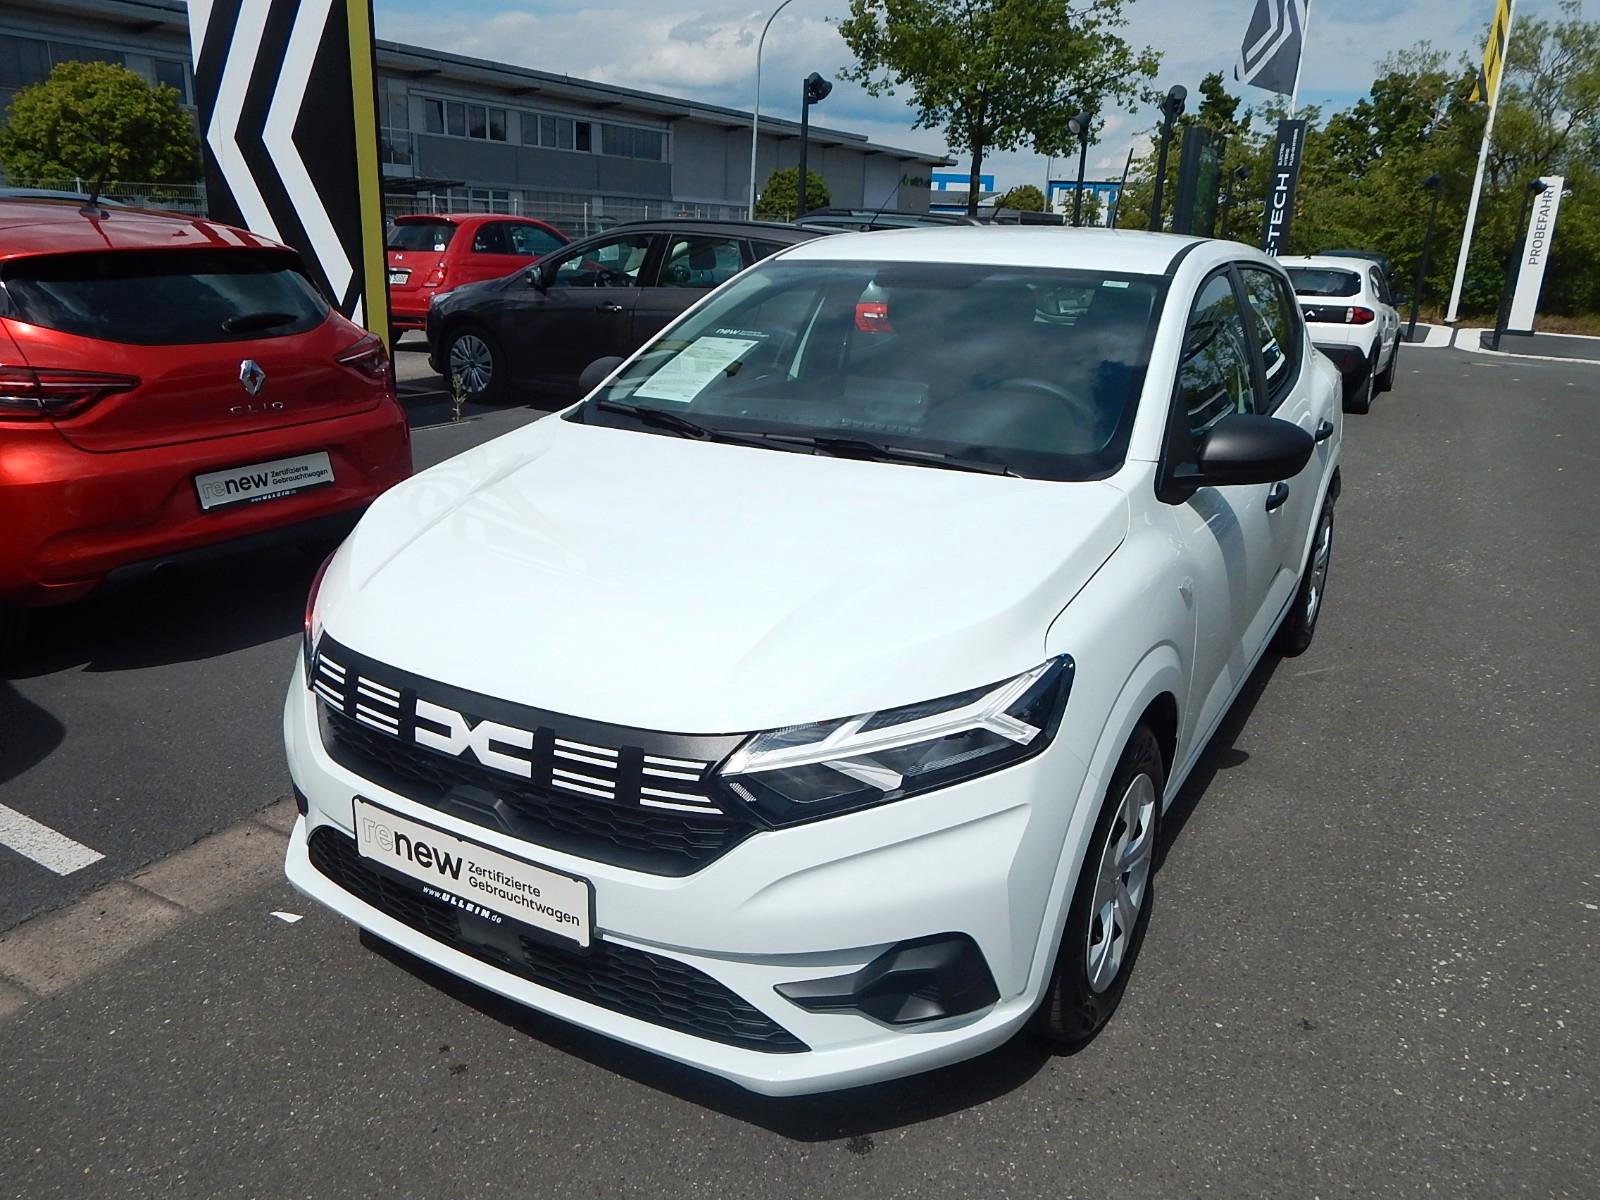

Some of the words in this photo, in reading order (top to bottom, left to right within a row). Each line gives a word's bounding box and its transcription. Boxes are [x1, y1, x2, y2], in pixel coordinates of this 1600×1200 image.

[271, 464, 309, 478] Zertifizierte
[272, 468, 328, 486] Gebrauchtwagen
[468, 861, 541, 898] Zertifizierte
[422, 885, 502, 924] www.ULLEIN.de
[468, 876, 580, 927] Gebrauchtwagen
